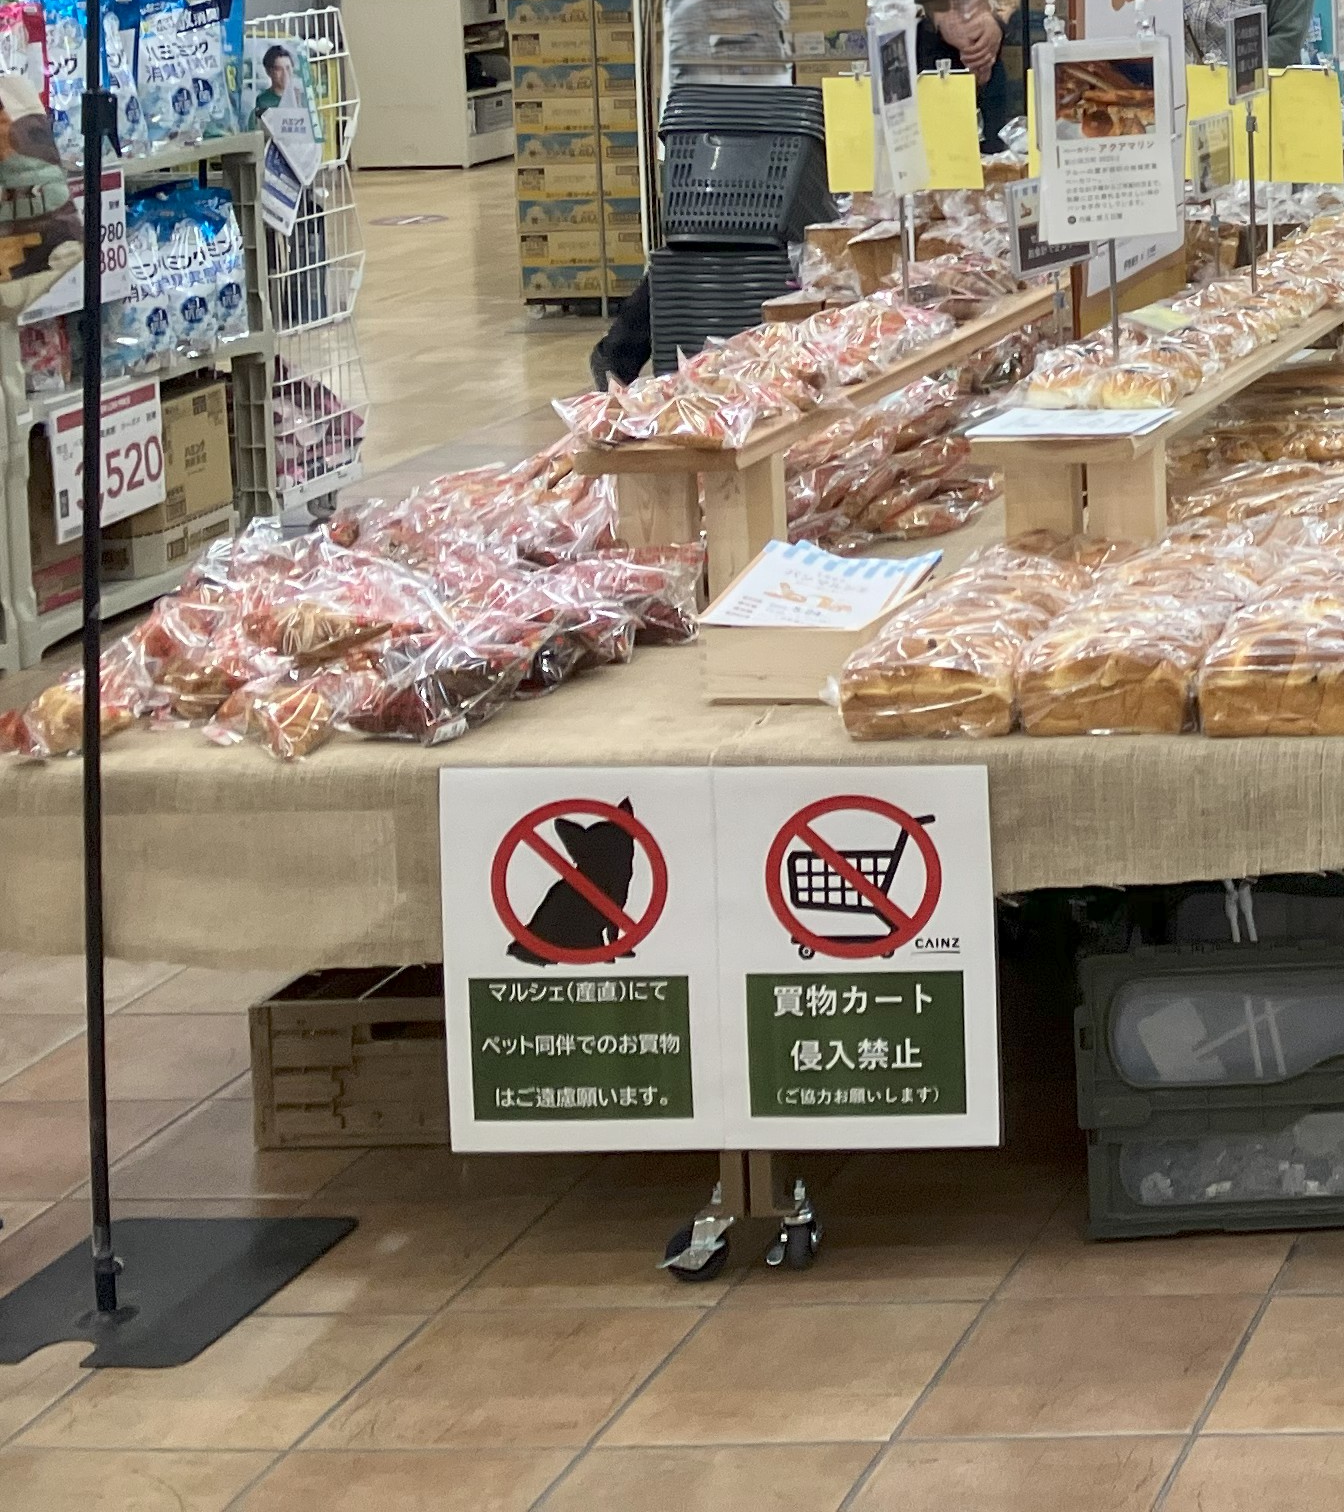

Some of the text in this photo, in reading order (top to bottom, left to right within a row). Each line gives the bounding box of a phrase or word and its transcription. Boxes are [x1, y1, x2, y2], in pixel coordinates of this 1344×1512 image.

[1098, 140, 1155, 152] アクアマリン
[915, 937, 961, 949] CAINZ
[488, 981, 668, 1004] マルシェ(産直)にて
[773, 985, 934, 1019] 買物カート
[482, 1034, 681, 1057] ペット同伴でのお買物
[790, 1039, 923, 1072] 侵入禁止
[495, 1085, 669, 1109] はご遠慮願います。
[776, 1086, 940, 1107] (ご協力お願いします)
